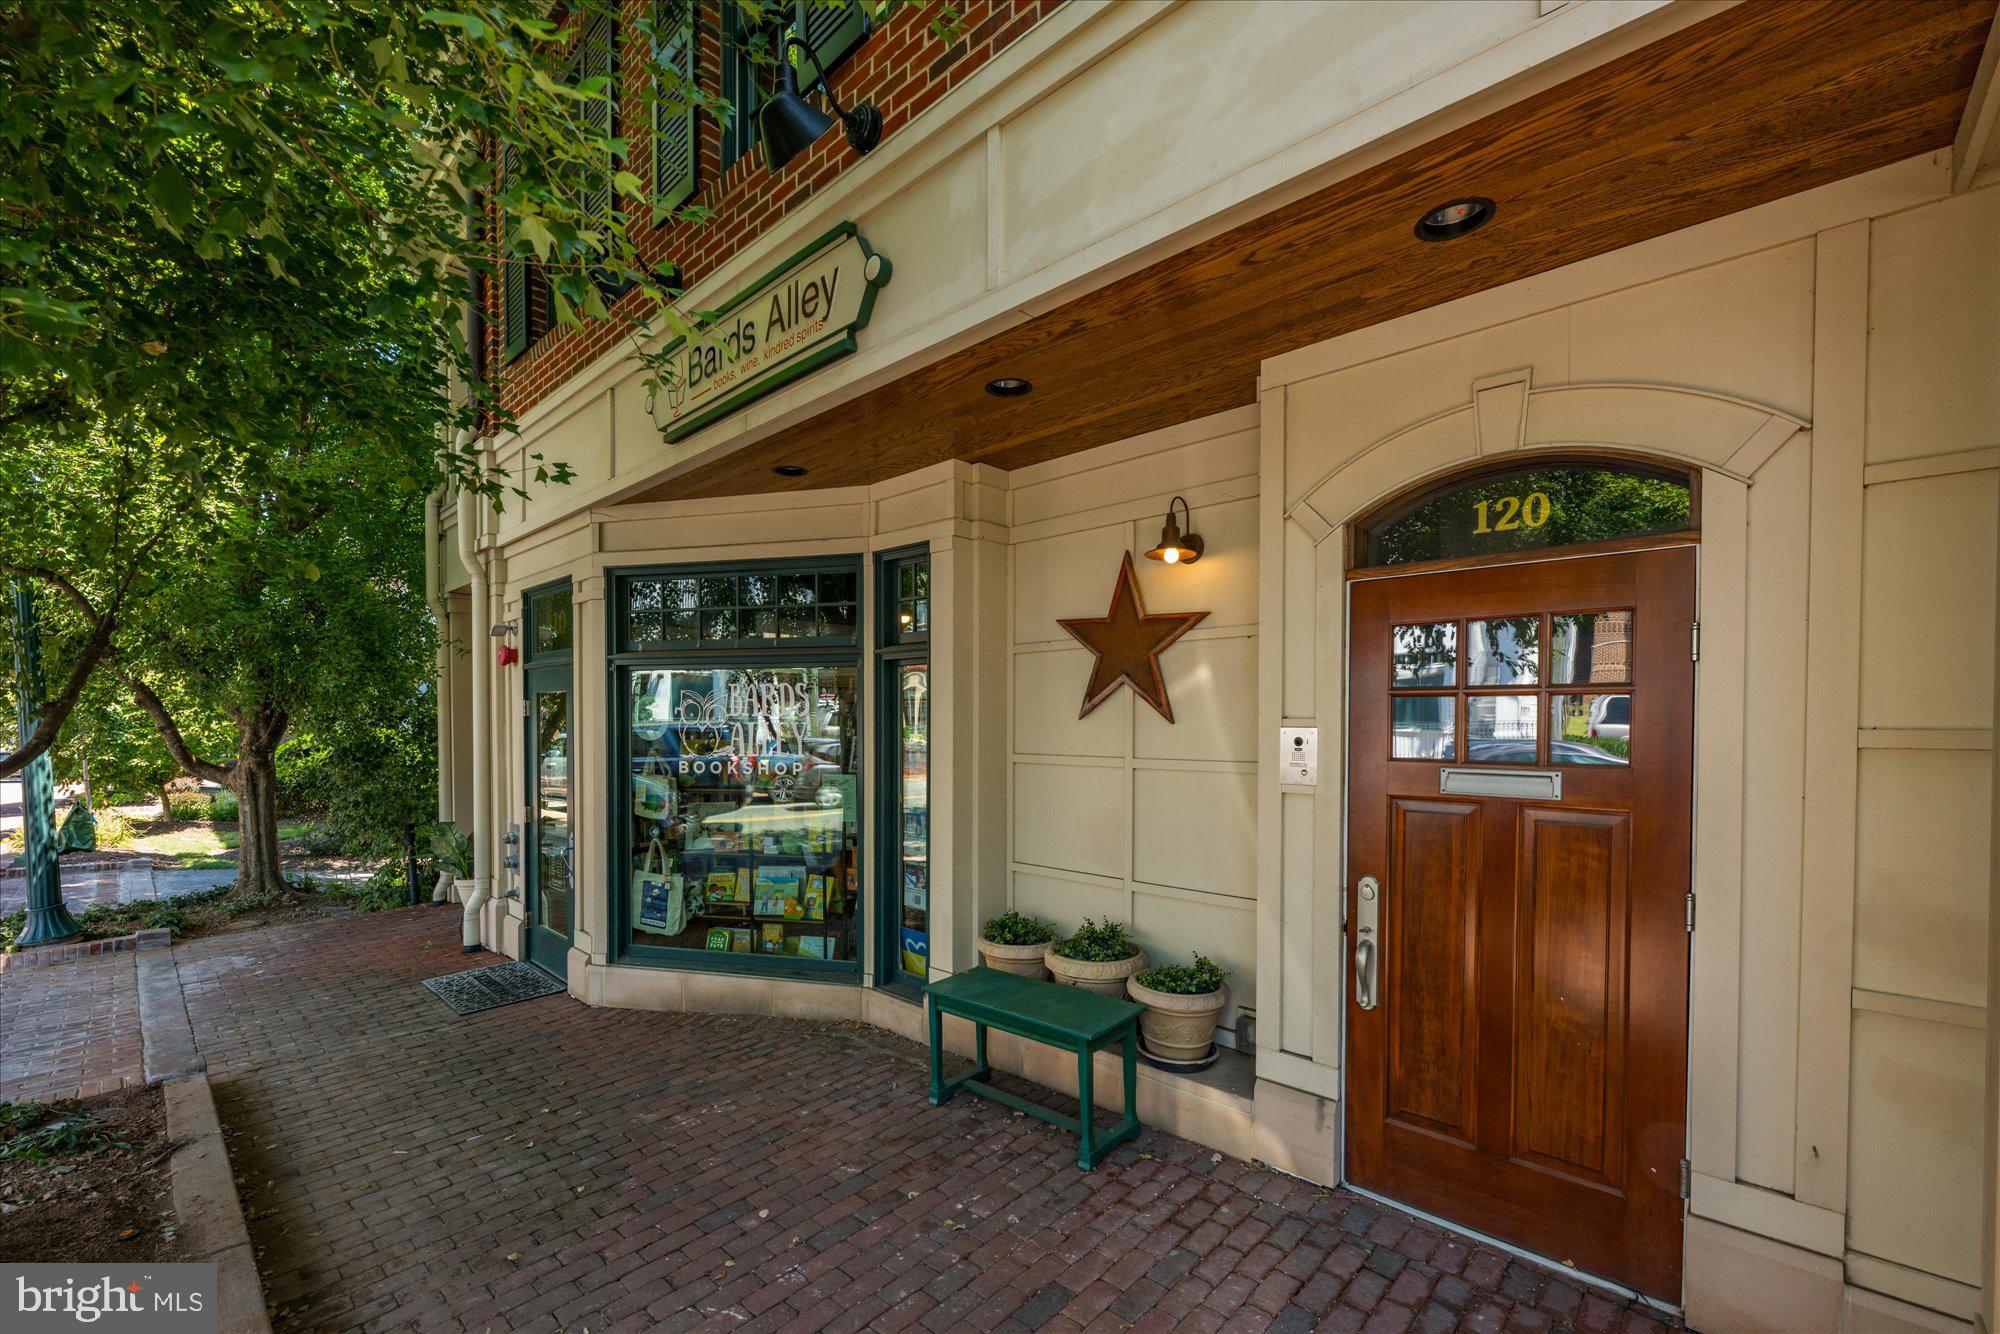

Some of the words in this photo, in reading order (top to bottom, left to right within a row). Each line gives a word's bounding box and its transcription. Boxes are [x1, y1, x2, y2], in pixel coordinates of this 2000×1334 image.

[688, 318, 756, 388] Bards
[765, 267, 840, 343] Alley
[763, 332, 795, 360] kindred
[796, 319, 824, 344] spirits
[1472, 492, 1551, 535] 120
[728, 682, 810, 717] BARDS
[731, 721, 808, 757] ALLEY
[679, 761, 803, 775] BOOKSHOP
